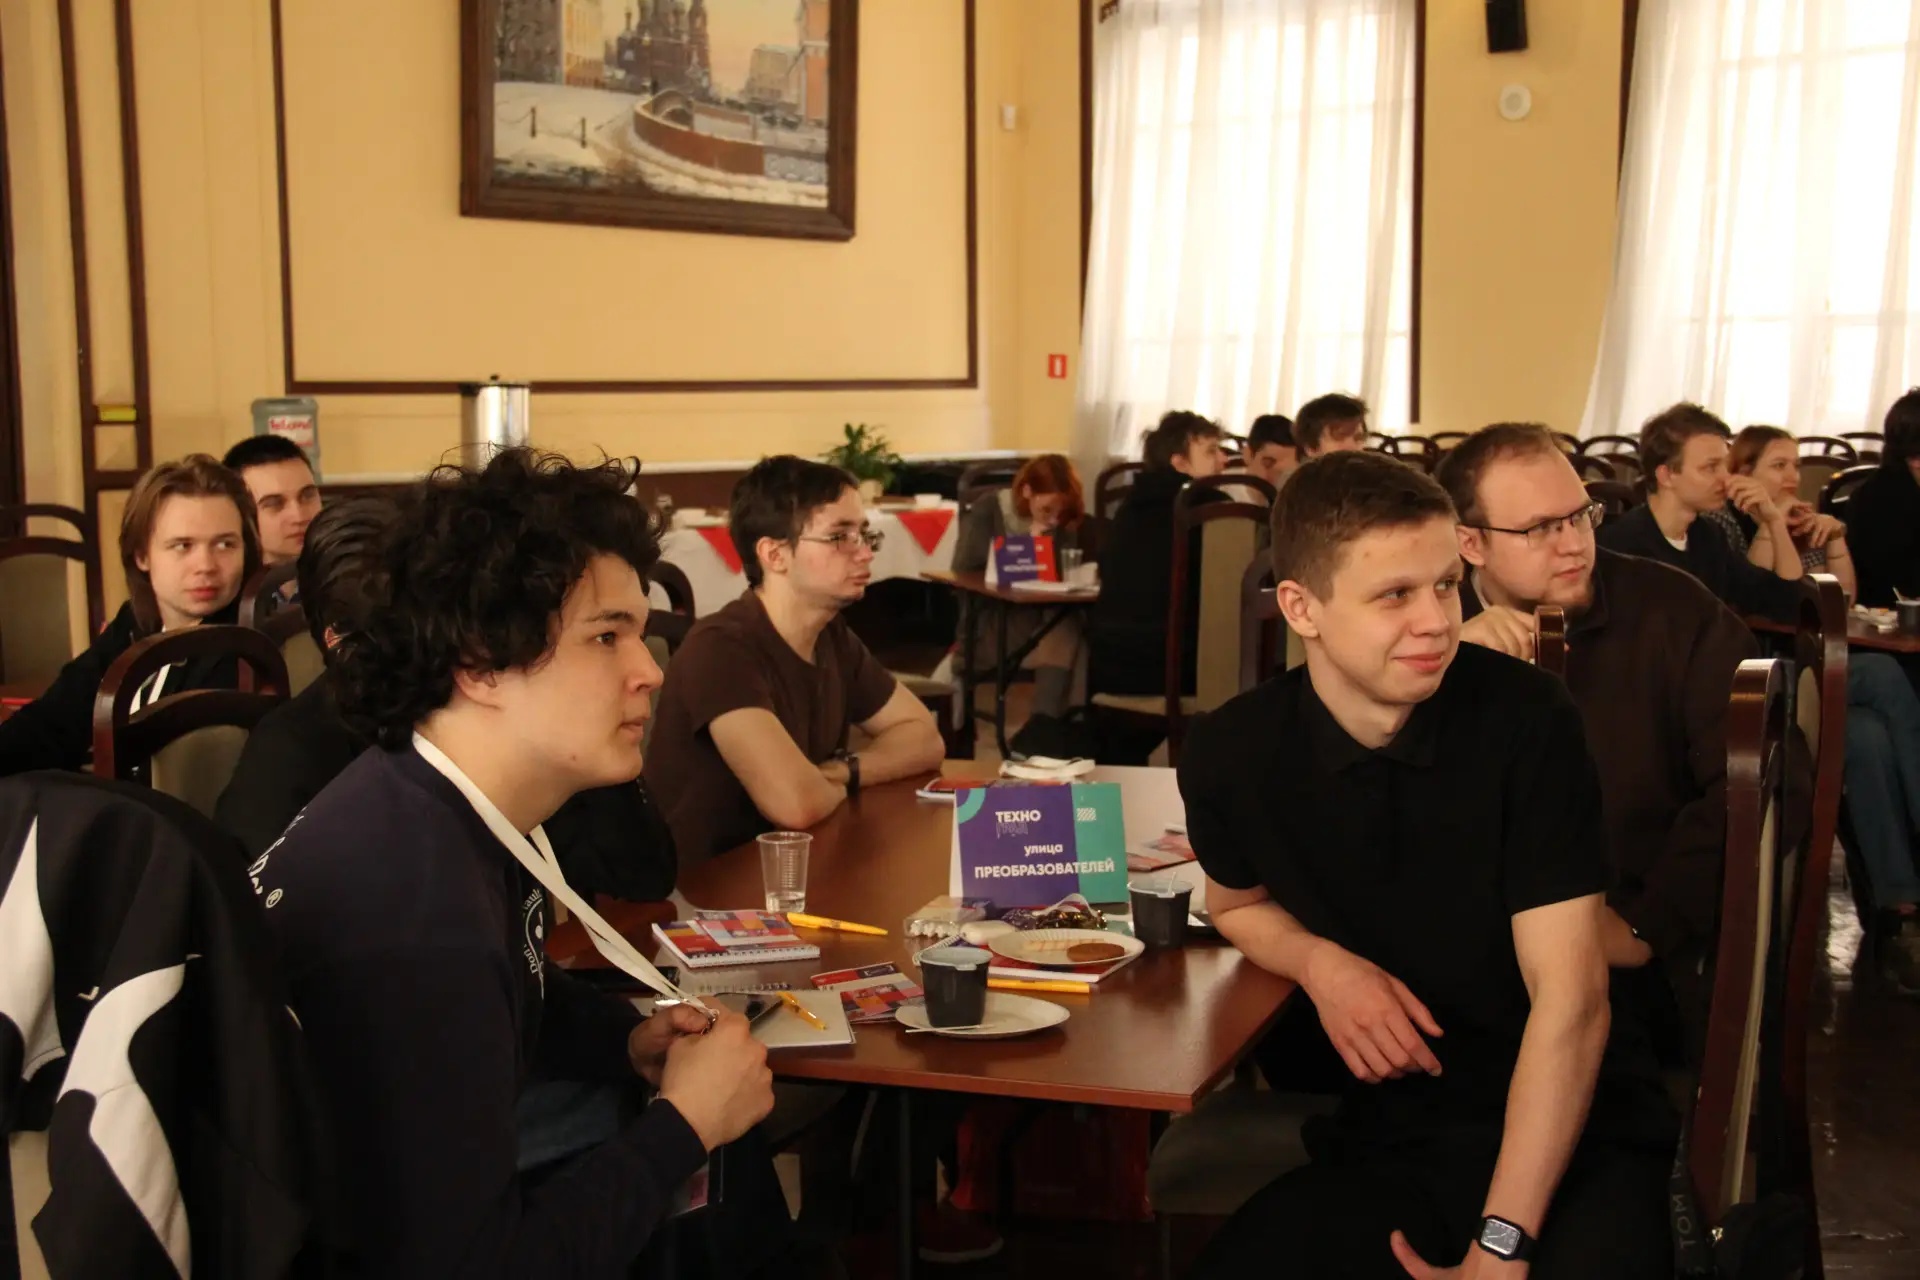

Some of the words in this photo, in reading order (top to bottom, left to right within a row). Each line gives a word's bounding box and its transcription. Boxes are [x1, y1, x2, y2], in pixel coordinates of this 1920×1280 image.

[995, 810, 1042, 823] ТЕХНО
[1024, 844, 1063, 857] улица
[974, 858, 1115, 879] ПРЕОБРАЗОВАТЕЛЕЙ
